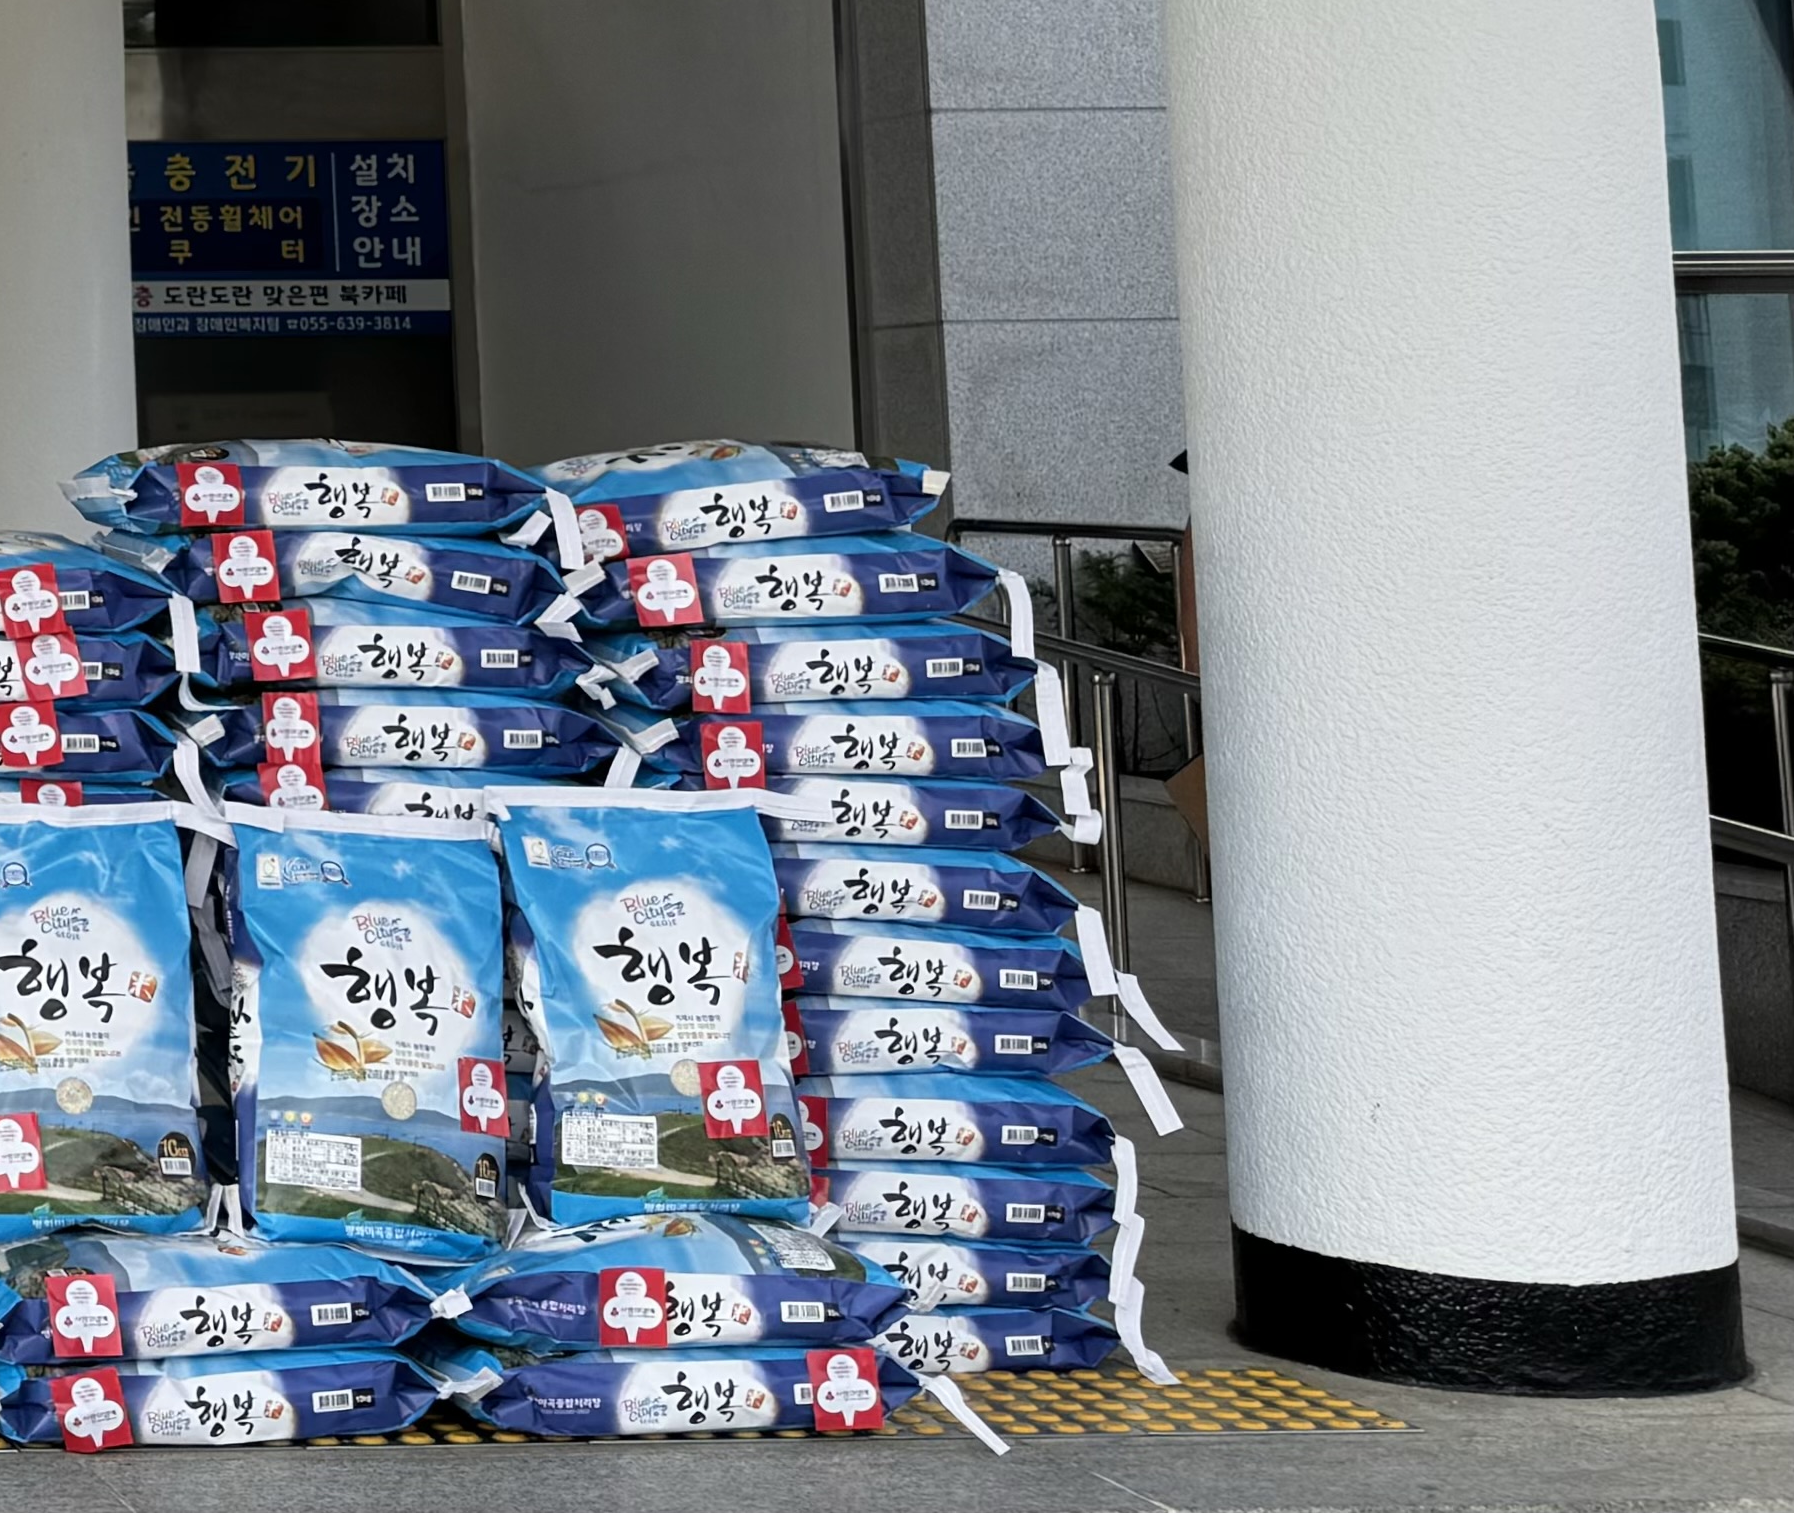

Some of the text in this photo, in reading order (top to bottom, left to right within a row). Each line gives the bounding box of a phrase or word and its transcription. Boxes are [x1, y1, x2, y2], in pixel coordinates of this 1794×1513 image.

[349, 152, 416, 187] 설치
[159, 205, 304, 233] 전동휠체어
[350, 195, 421, 229] 장소
[353, 236, 422, 269] 안내
[164, 285, 253, 307] 도란도란
[263, 285, 330, 308] 맞은편
[340, 284, 408, 306] 북카페
[305, 473, 380, 518] 행복
[700, 493, 780, 538] 행복
[756, 566, 833, 614] 행복
[358, 633, 437, 679] 행복
[808, 651, 883, 697] 행복
[382, 714, 459, 761] 행복
[831, 724, 907, 769] 행복
[831, 790, 901, 840] 행복
[844, 870, 919, 915] 행복
[593, 927, 731, 1005] 행복
[878, 947, 954, 997] 행복
[321, 947, 451, 1036] 행복
[875, 1018, 952, 1065] 행복
[880, 1107, 957, 1154] 행복
[883, 1182, 961, 1232] 행복
[180, 1296, 262, 1347] 행복
[885, 1321, 959, 1371] 행복
[185, 1386, 262, 1438] 행복
[661, 1372, 746, 1424] 행복
